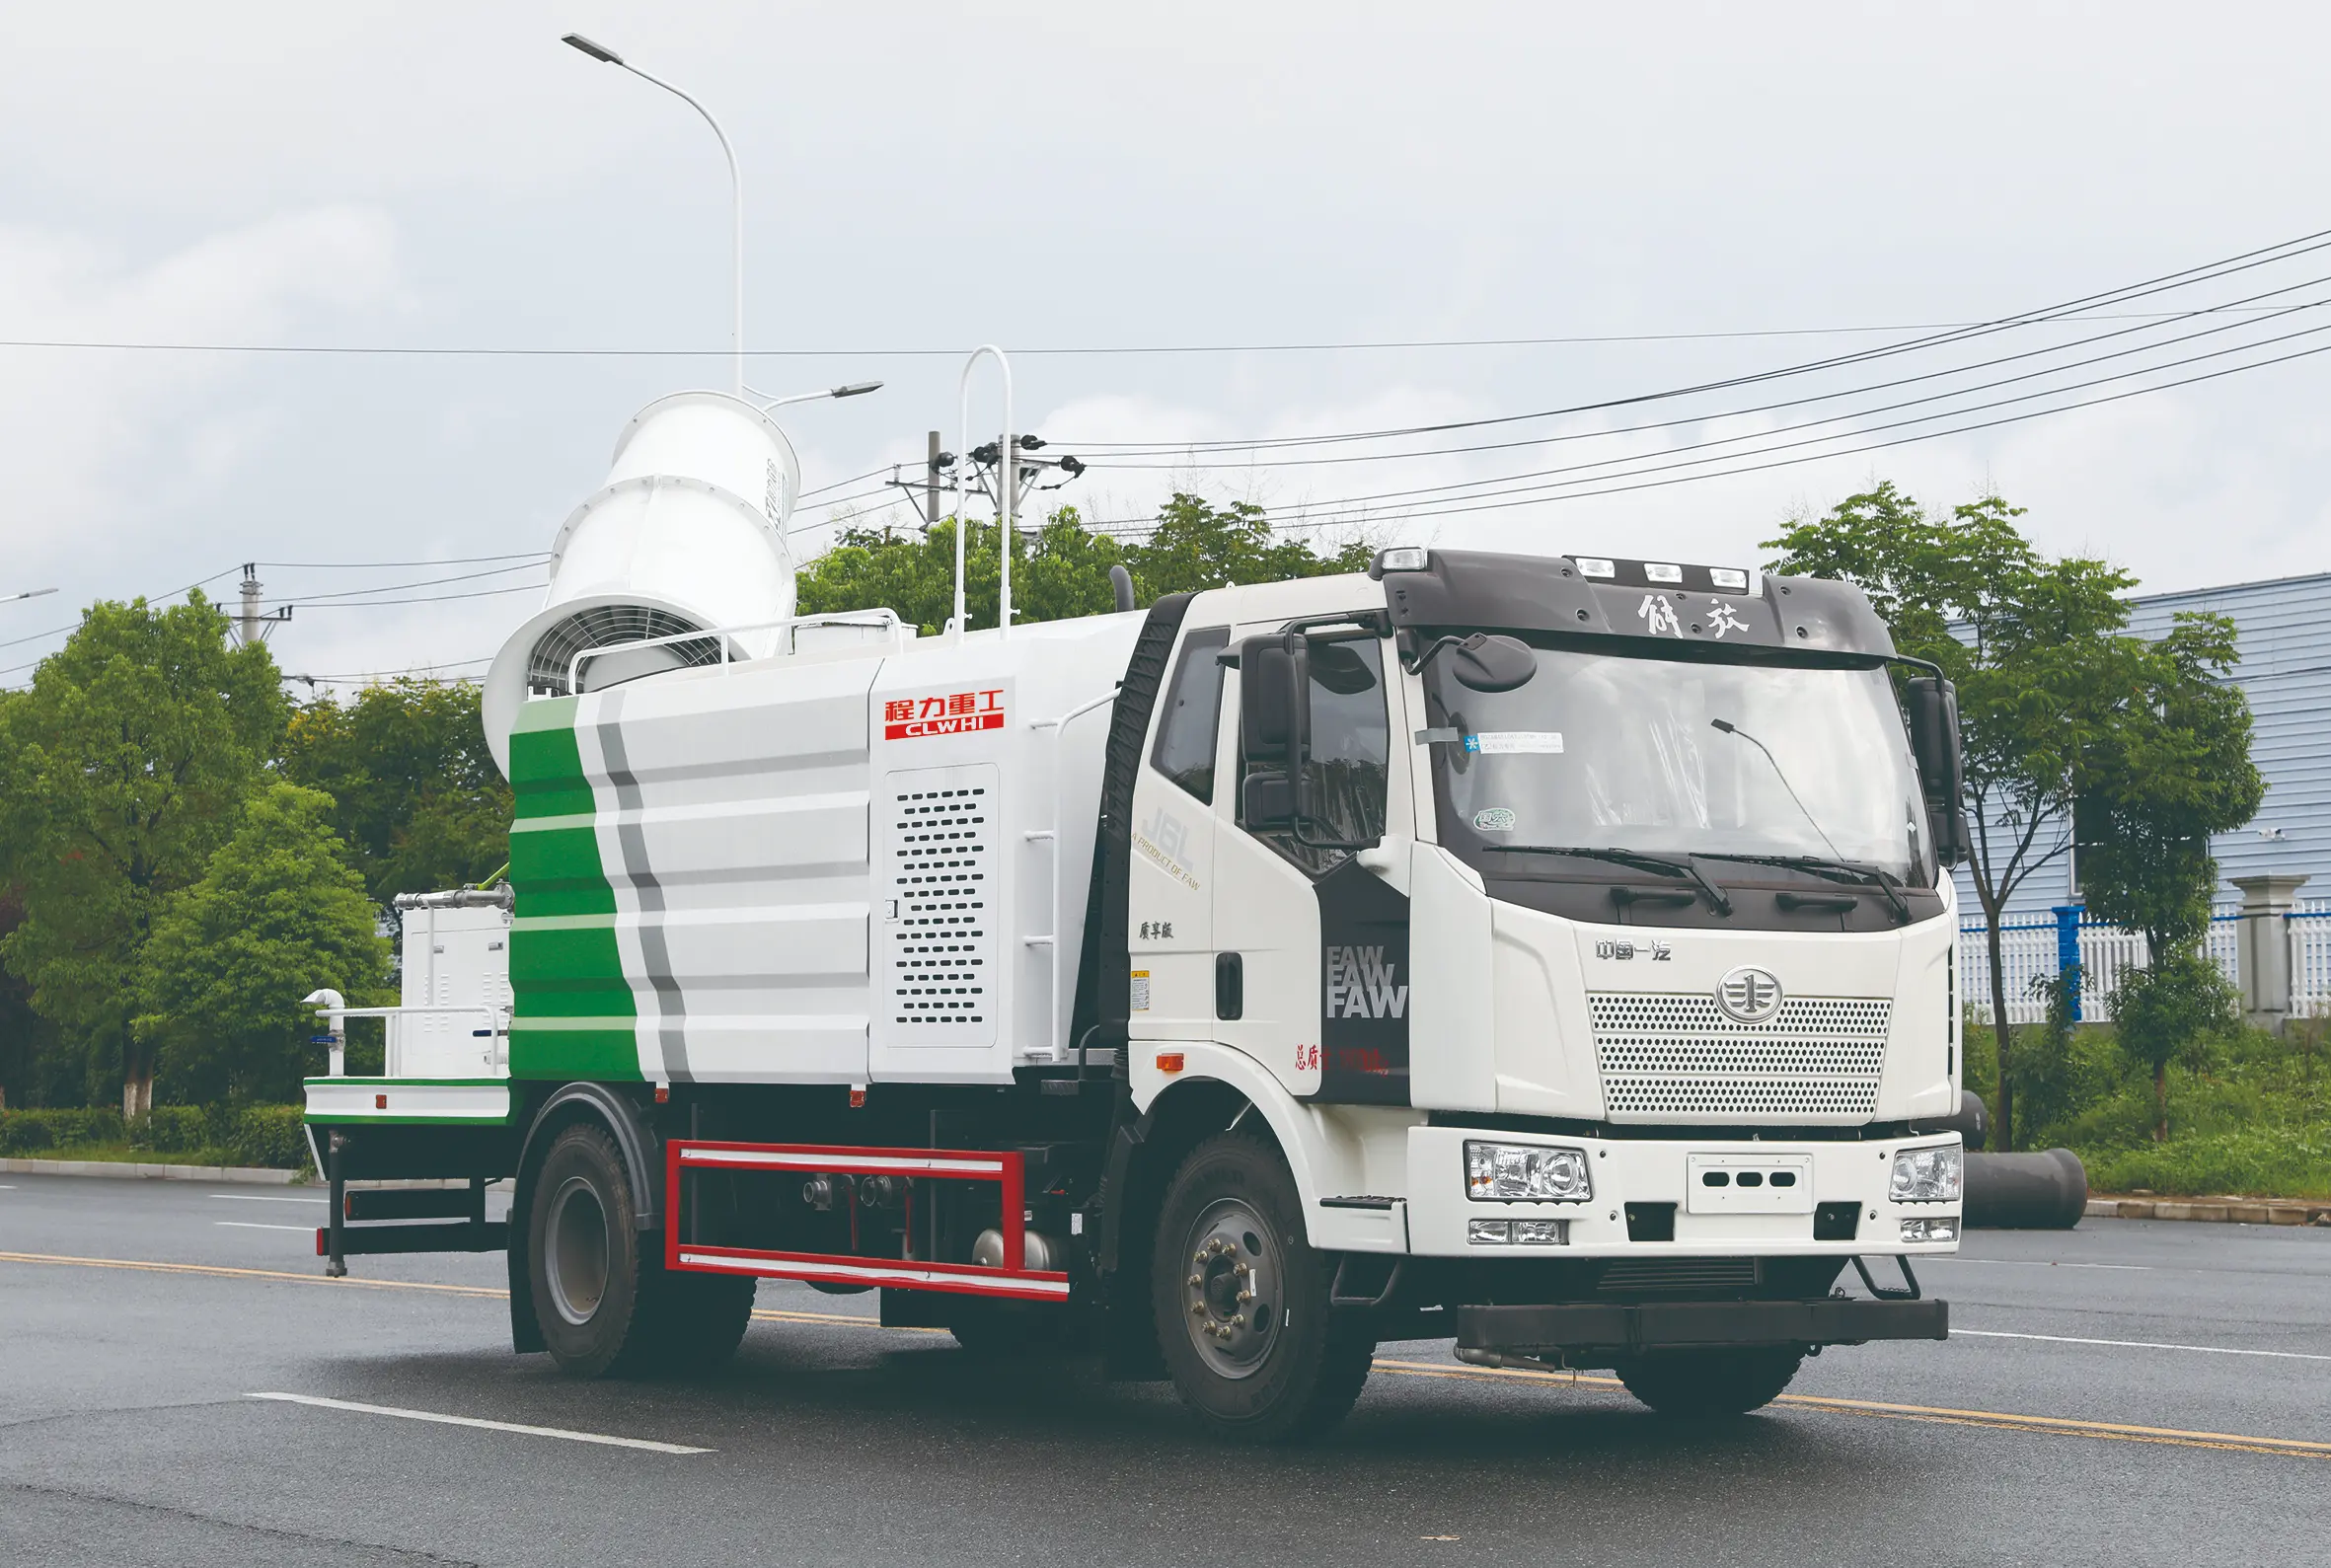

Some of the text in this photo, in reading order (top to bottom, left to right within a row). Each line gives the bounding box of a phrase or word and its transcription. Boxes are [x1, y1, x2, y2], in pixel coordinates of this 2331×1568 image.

[884, 689, 1005, 722] 程力重工
[905, 715, 985, 737] CLWHI
[1131, 832, 1201, 891] A PRODUCT OF FAW
[1326, 945, 1385, 969] FAW
[1595, 938, 1672, 962] 中国一汽
[1326, 963, 1395, 990] FAW
[1326, 985, 1409, 1019] FAW
